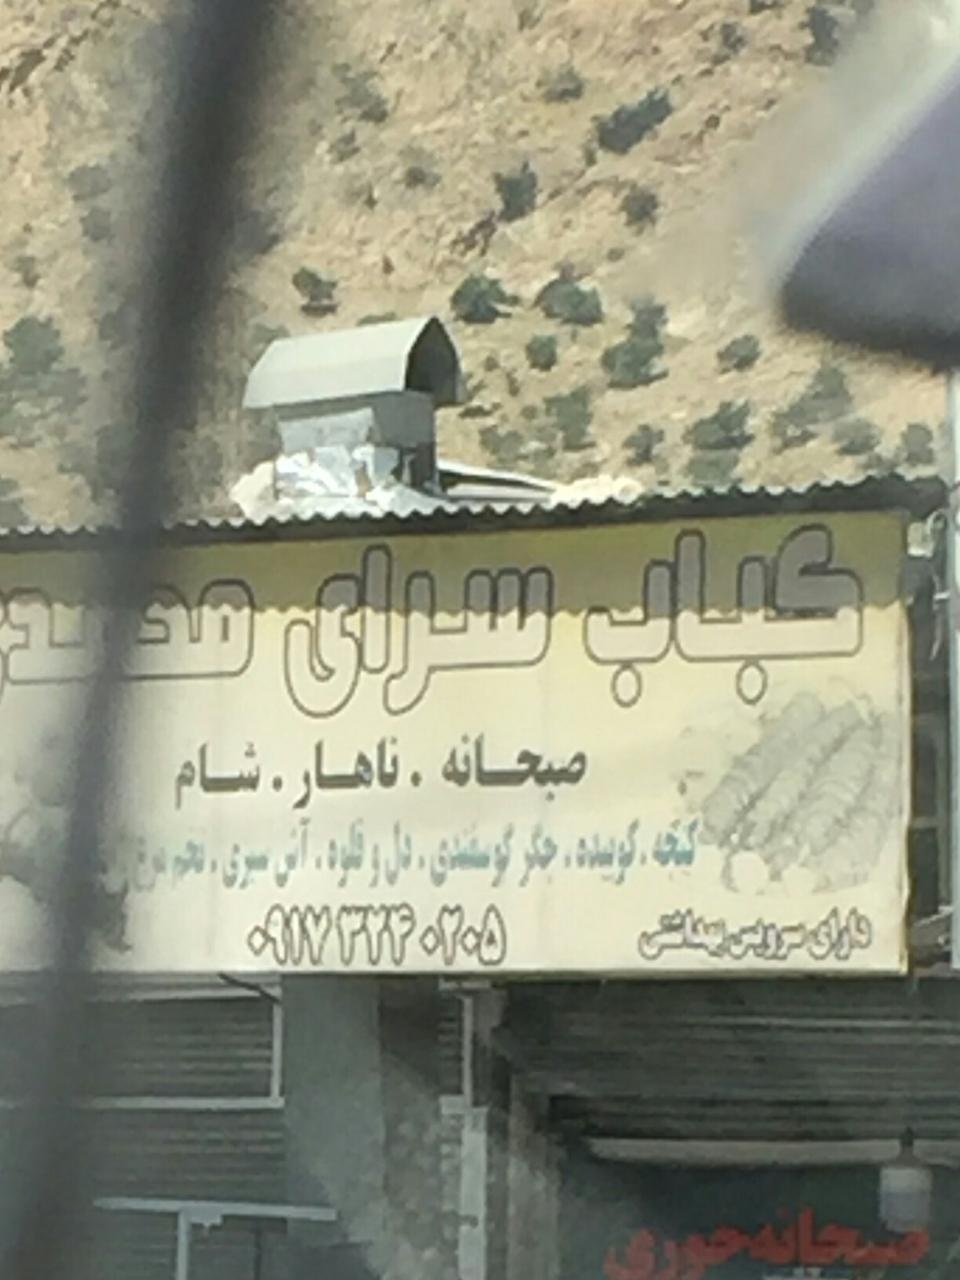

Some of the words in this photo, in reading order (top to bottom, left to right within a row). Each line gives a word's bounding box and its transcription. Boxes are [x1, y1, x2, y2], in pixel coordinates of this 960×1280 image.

[284, 543, 555, 718] سرای
[582, 523, 864, 708] کباب
[174, 741, 261, 811] شام
[293, 736, 400, 809] ناهار
[441, 734, 589, 802] صبحانه
[807, 906, 872, 961] دارای
